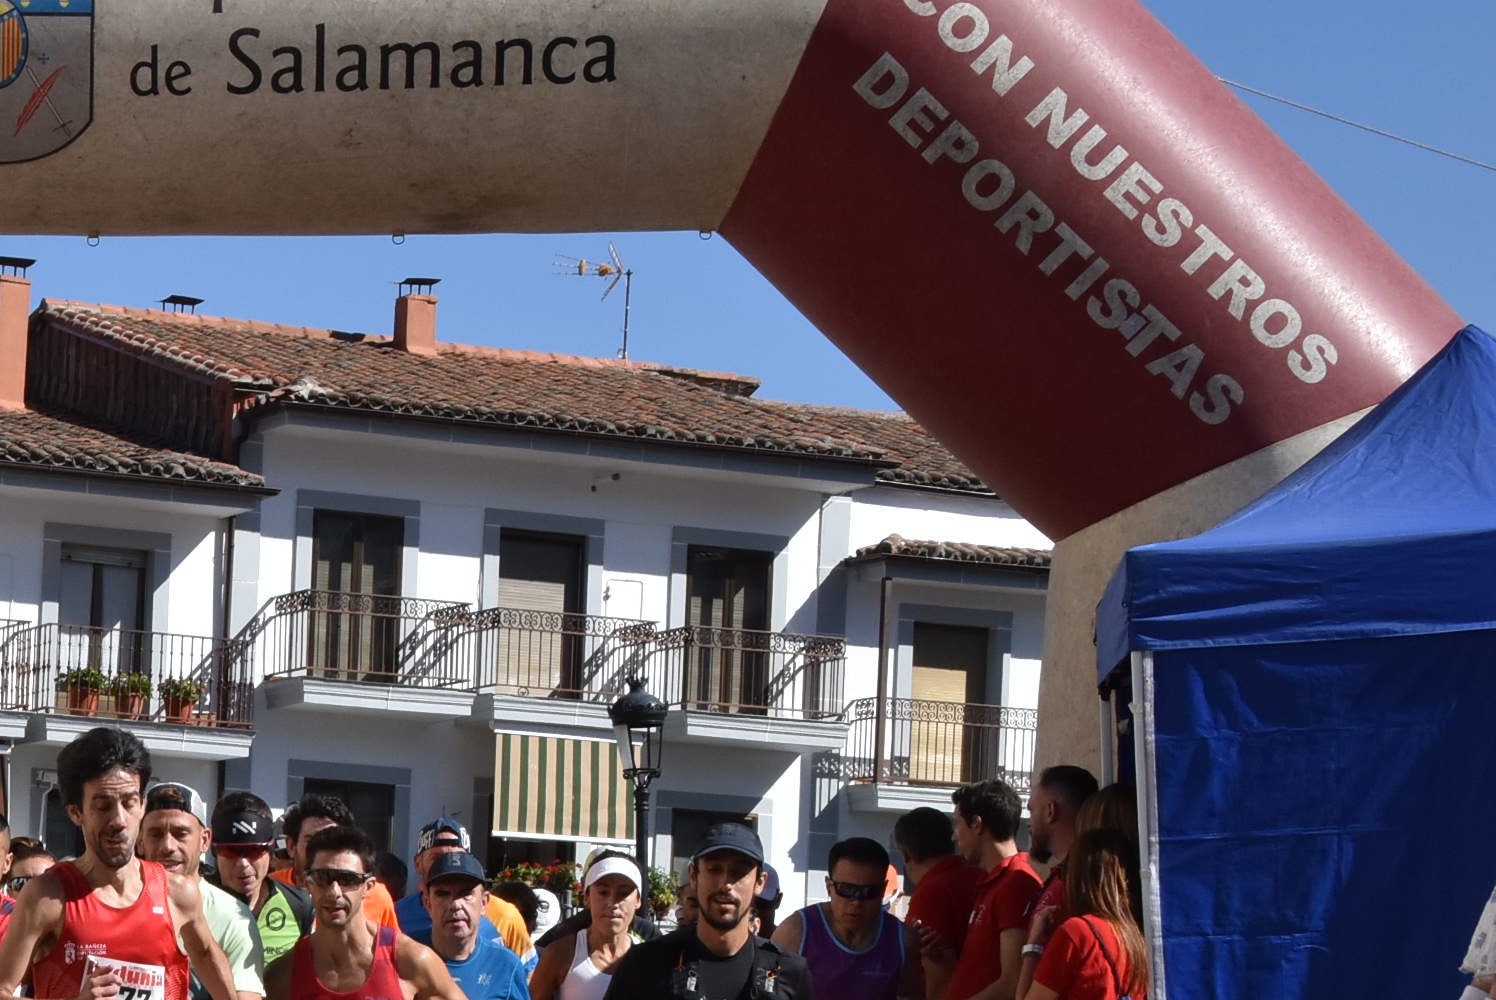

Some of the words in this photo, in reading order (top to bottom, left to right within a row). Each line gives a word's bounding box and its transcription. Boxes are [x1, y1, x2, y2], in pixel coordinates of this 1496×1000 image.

[129, 45, 192, 97] de
[226, 23, 618, 95] Salamanca
[852, 51, 1245, 425] DEPORTISTAS
[1024, 87, 1339, 384] NUESTROS
